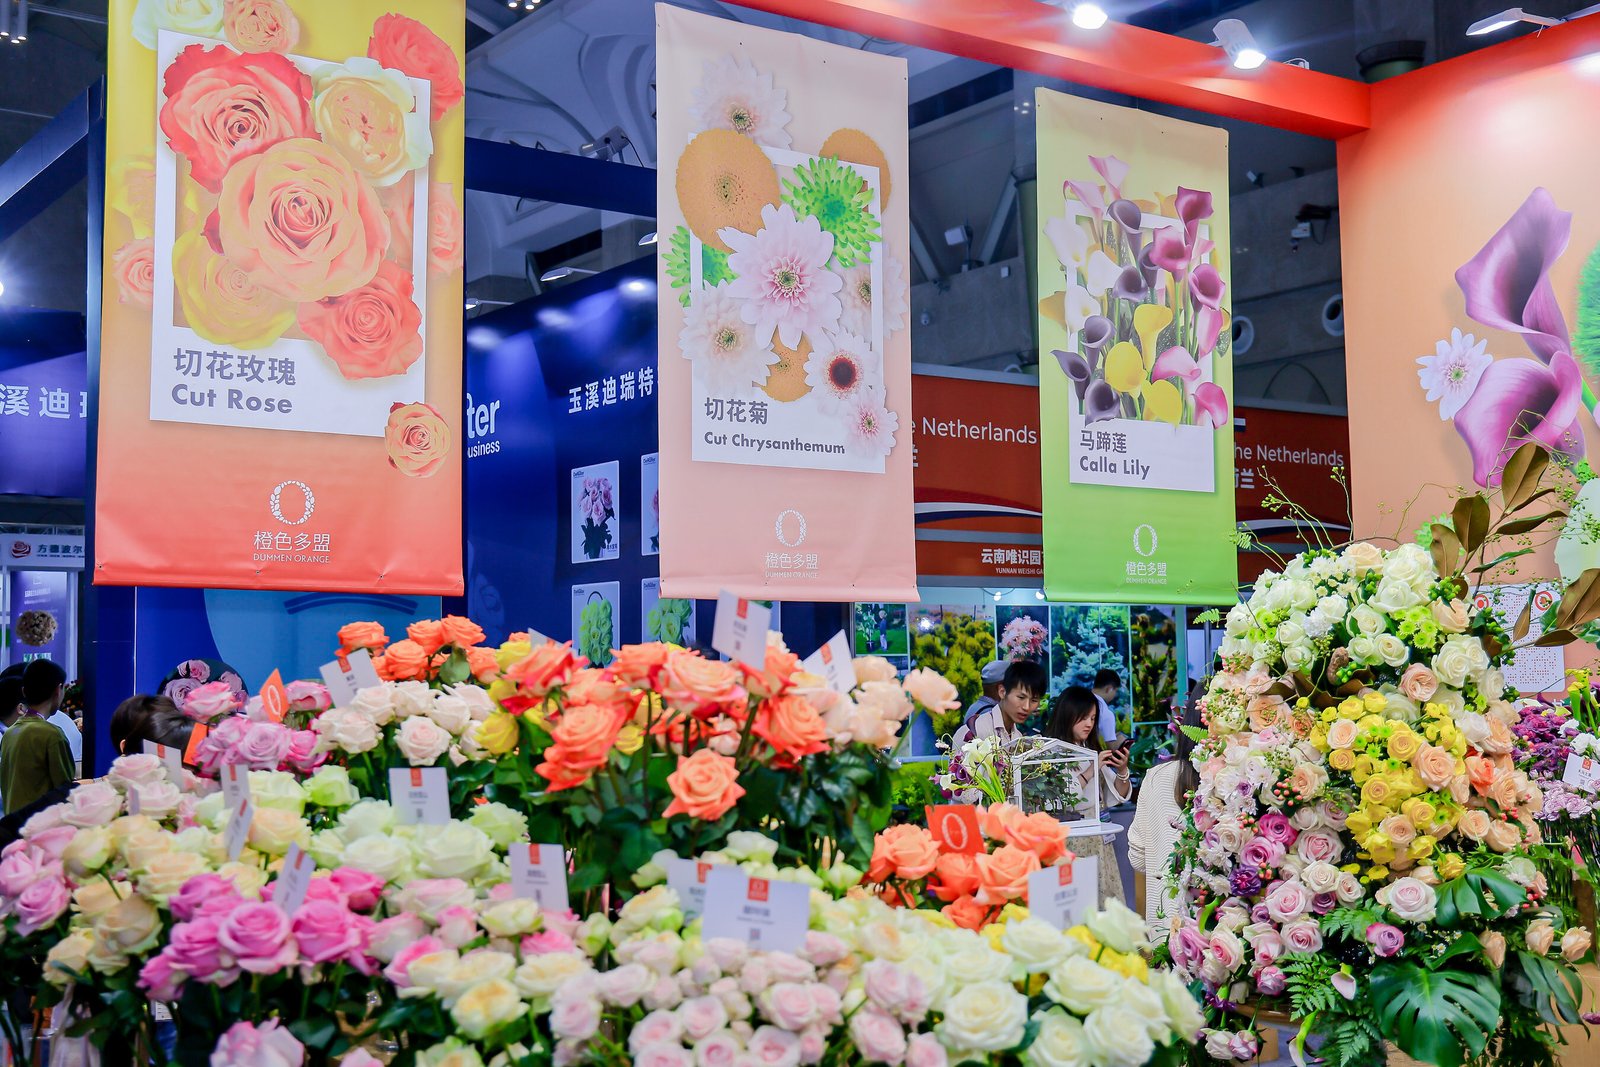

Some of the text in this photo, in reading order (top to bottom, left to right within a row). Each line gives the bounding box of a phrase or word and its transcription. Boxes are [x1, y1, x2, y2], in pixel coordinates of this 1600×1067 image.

[173, 347, 297, 386] 切花玫瑰
[171, 383, 293, 414] Cut Rose
[568, 366, 654, 414] 玉溪迪瑞特
[704, 397, 768, 425] 切花菊
[704, 431, 846, 454] Cut Chrysanthemum
[922, 416, 1038, 445] Netherlands
[1080, 429, 1127, 454] 马蹄莲
[1079, 455, 1151, 480] Calla Lily
[1257, 444, 1344, 467] Netherlands
[253, 530, 331, 552] 橙色多盟
[294, 554, 331, 563] ORANGE
[981, 548, 1044, 566] 云南唯识园
